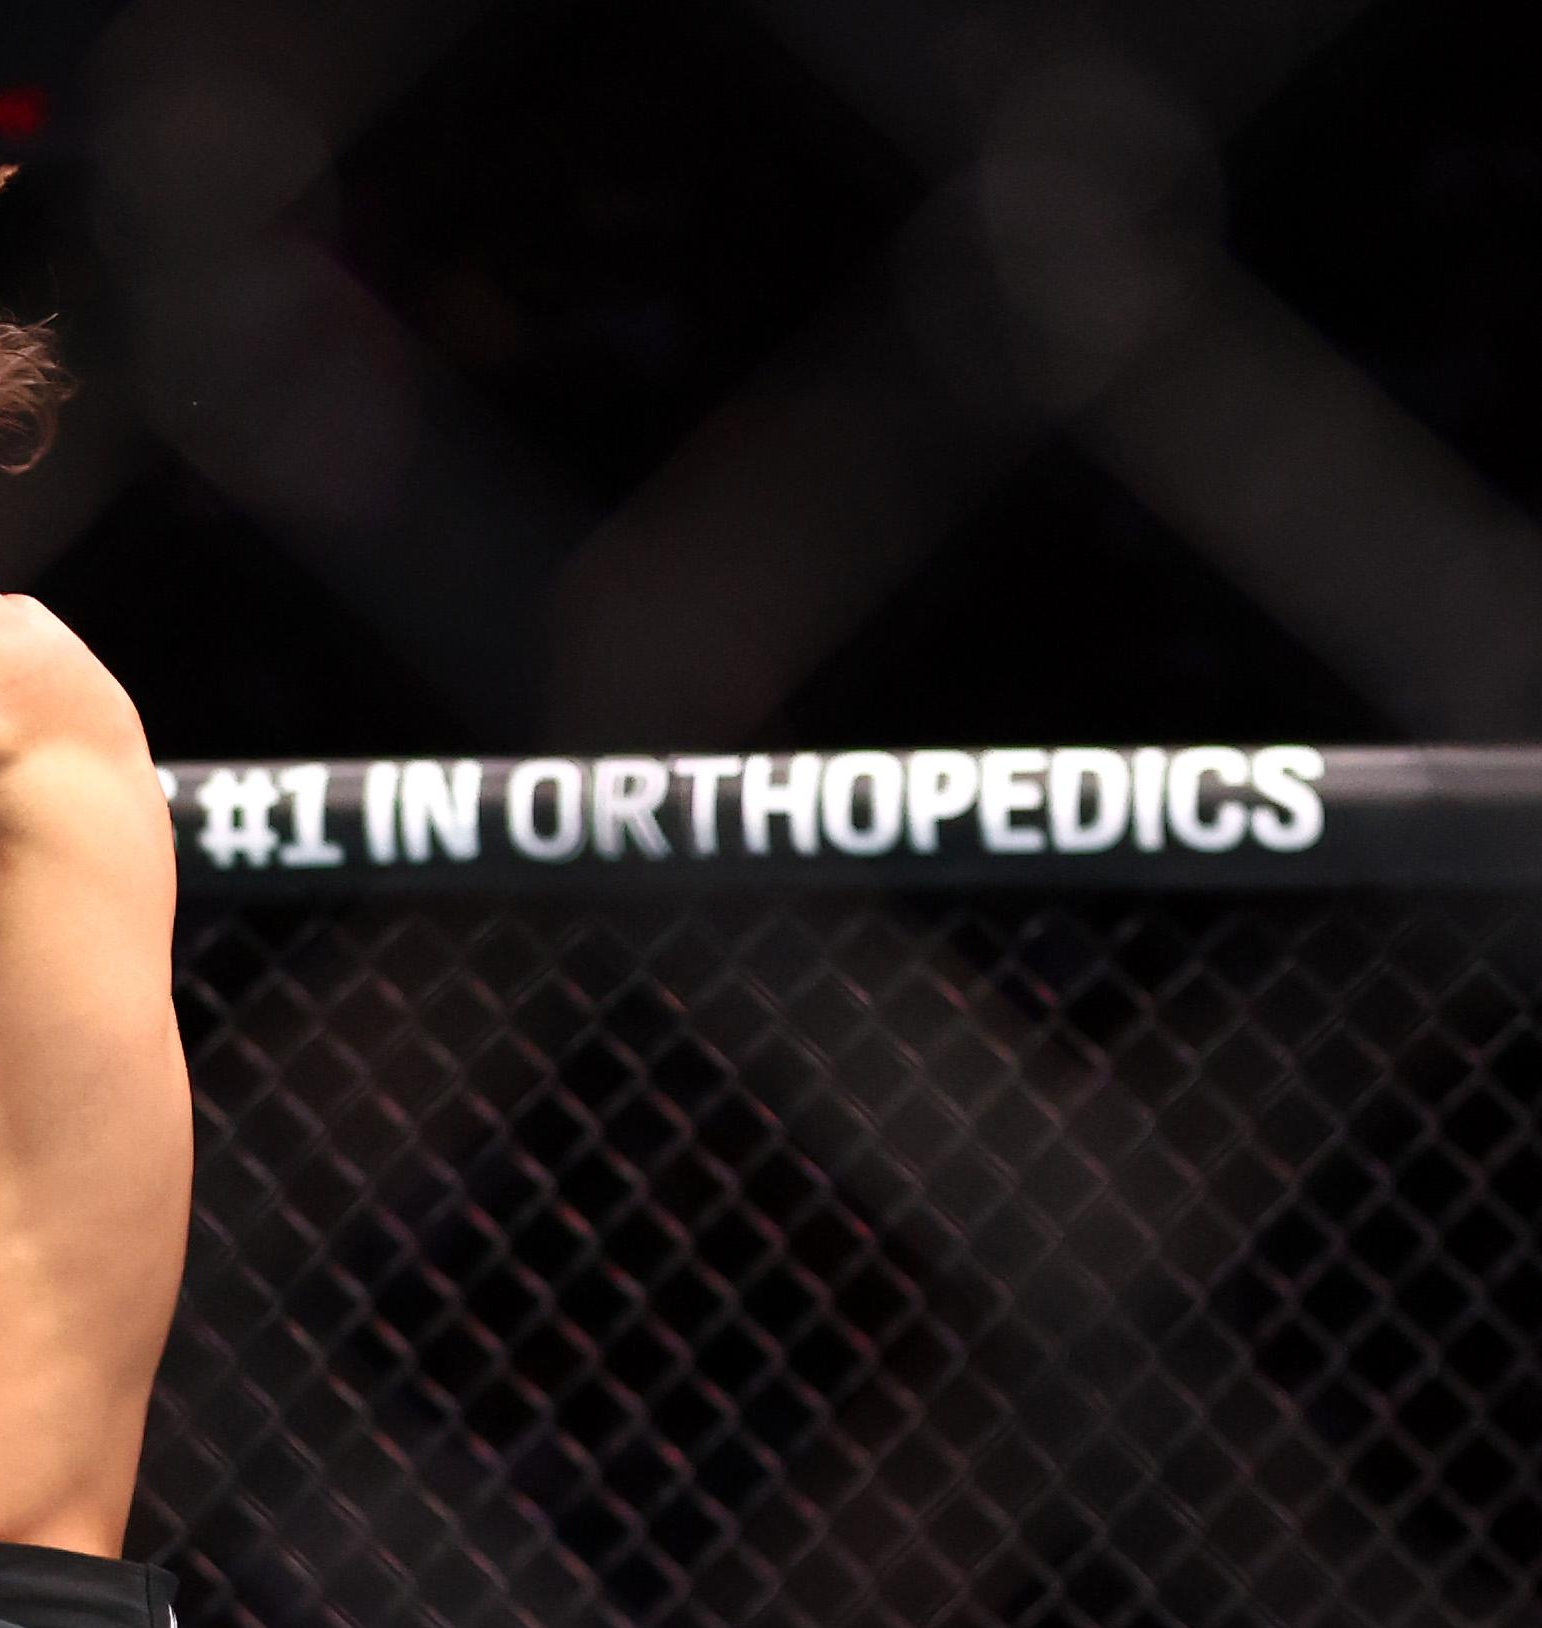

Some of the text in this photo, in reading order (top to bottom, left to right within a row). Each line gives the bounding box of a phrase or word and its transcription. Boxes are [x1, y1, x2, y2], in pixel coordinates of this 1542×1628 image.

[197, 762, 346, 869] #1
[363, 757, 483, 865] IN
[507, 744, 1326, 864] ORTHOPEDICS
